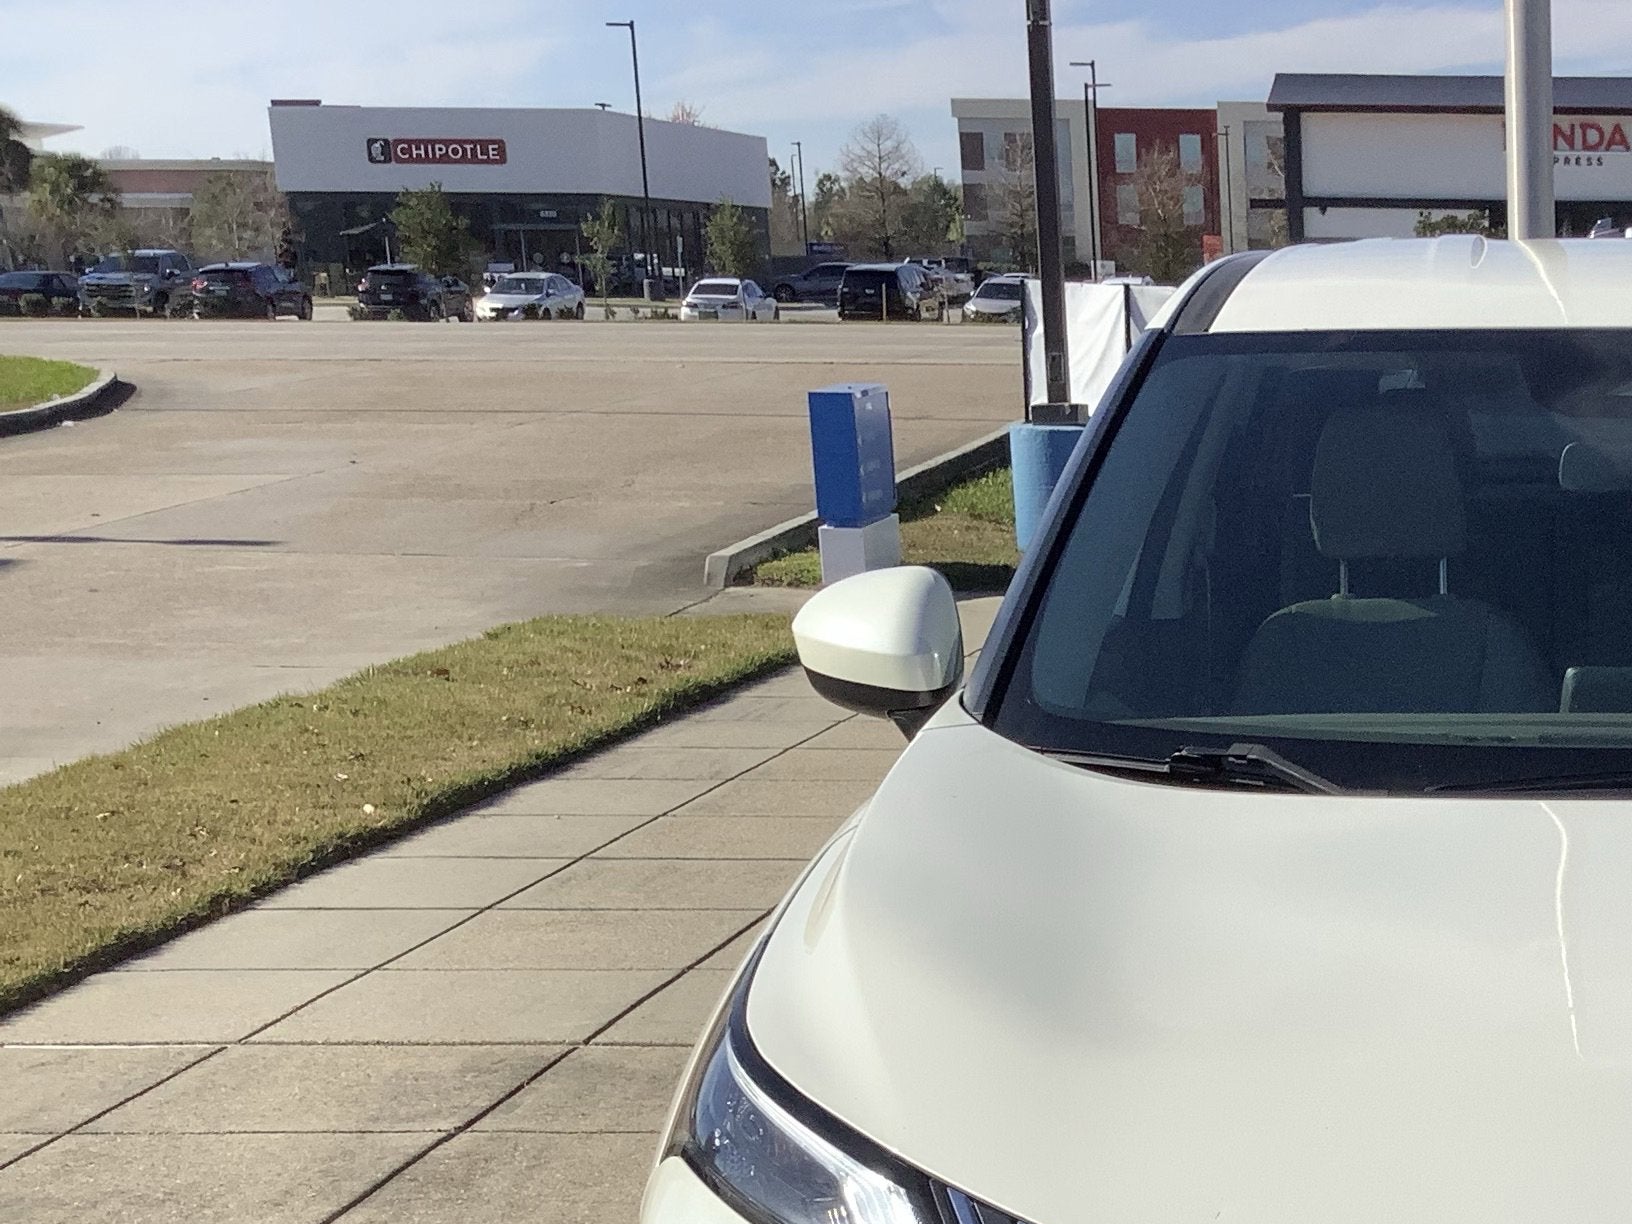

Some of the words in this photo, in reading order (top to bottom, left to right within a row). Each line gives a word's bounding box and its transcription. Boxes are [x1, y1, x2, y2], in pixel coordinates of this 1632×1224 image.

[1502, 121, 1632, 152] NDA
[396, 143, 500, 159] CHIPOTLE
[1552, 154, 1604, 167] PRESS
